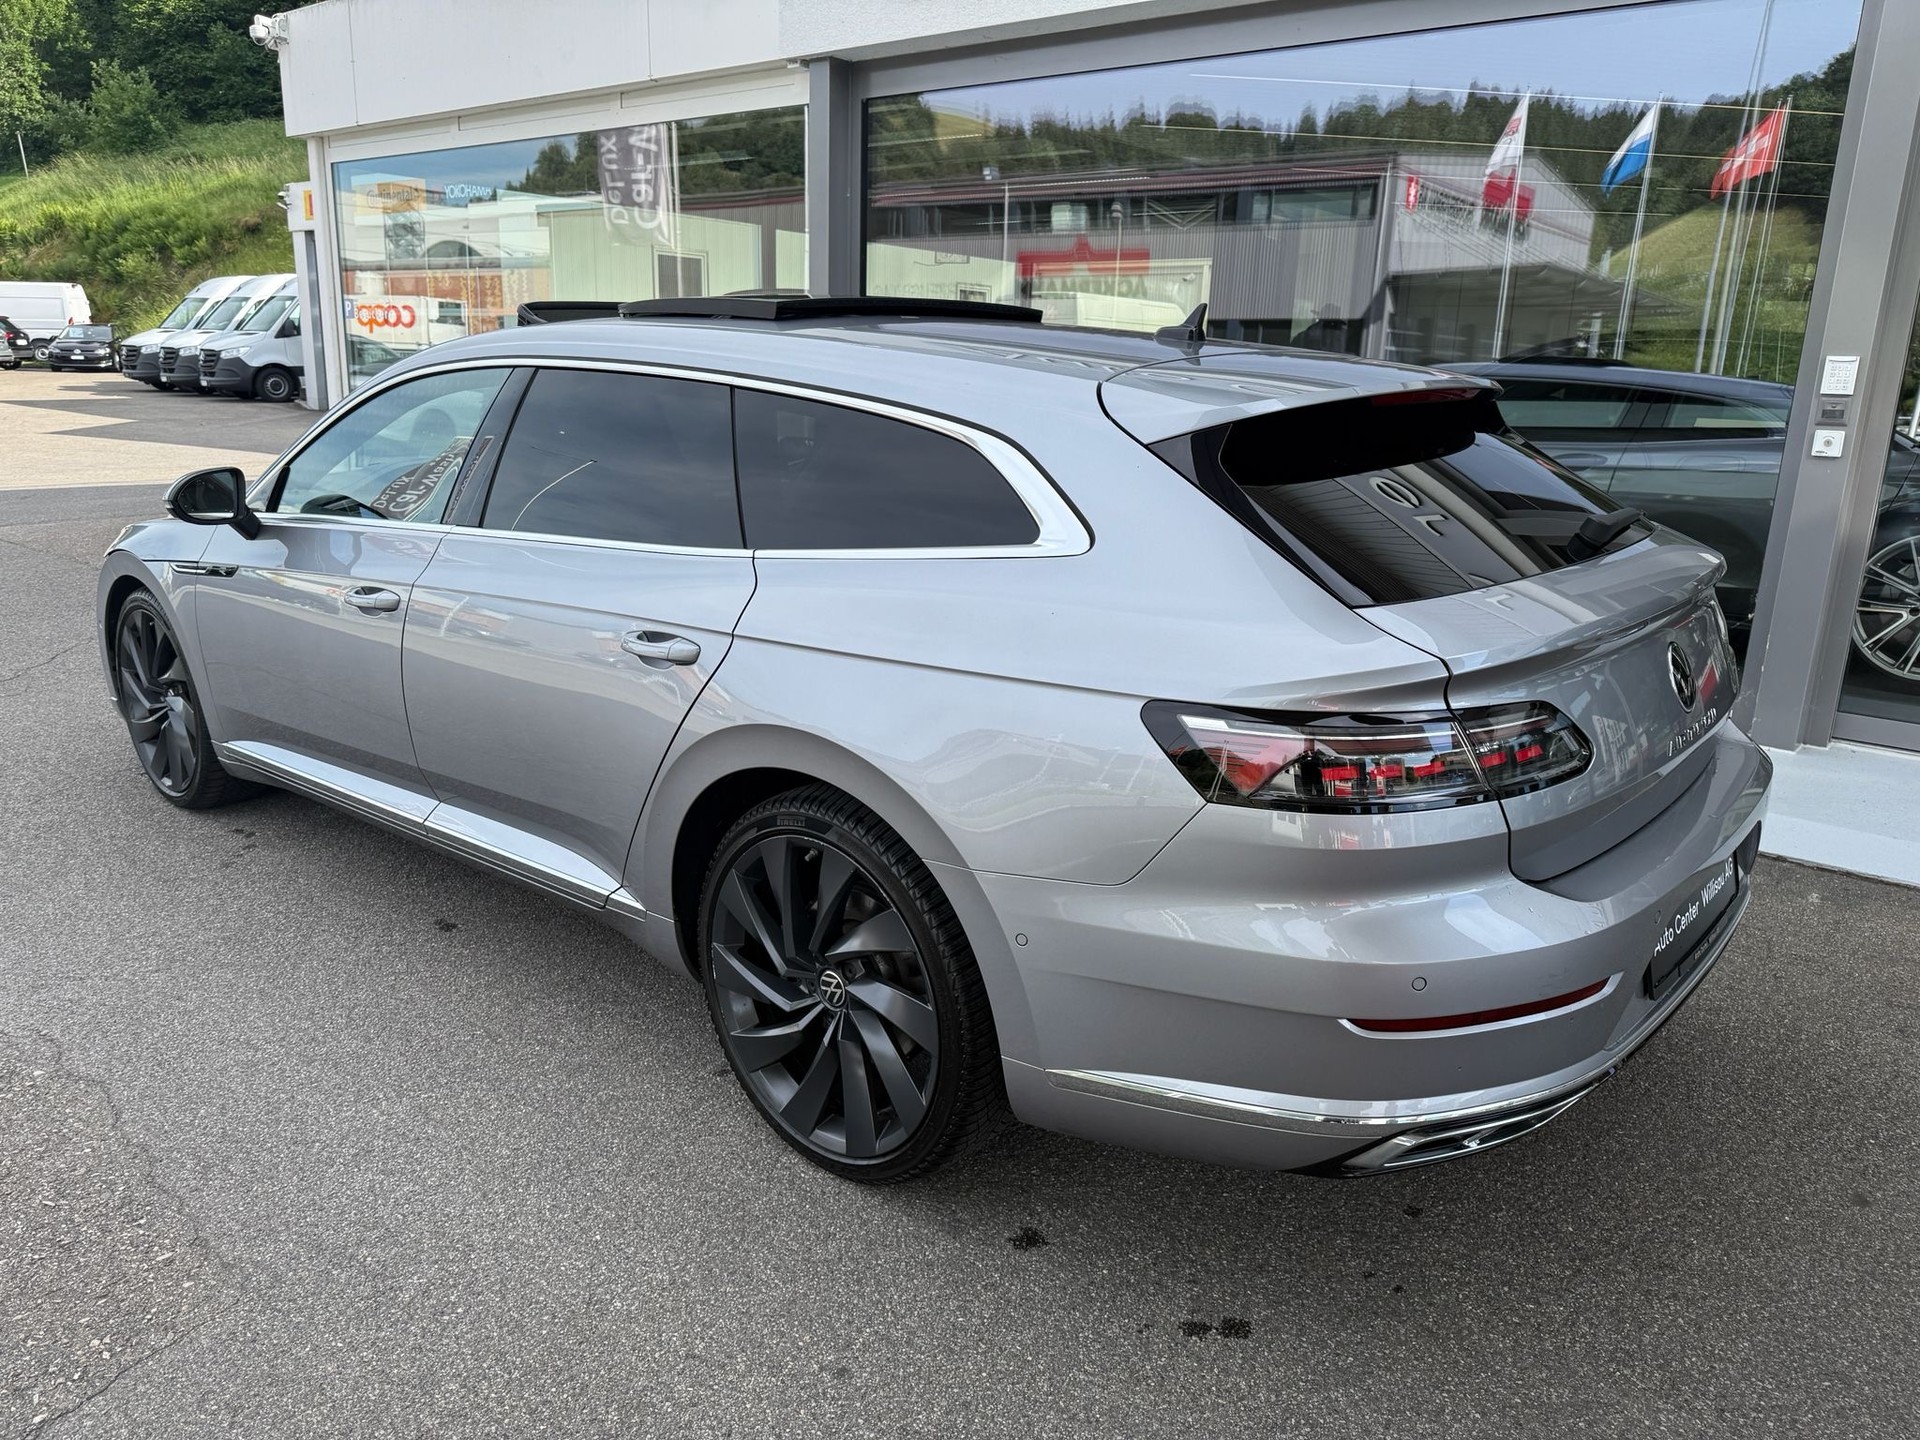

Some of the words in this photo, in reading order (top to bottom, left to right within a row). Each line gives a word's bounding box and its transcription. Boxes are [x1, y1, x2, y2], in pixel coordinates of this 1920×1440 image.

[444, 183, 492, 199] YOKOHAMA
[1654, 927, 1674, 957] Auto
[1674, 900, 1699, 934] Center
[1701, 872, 1725, 907] Willisau
[1725, 857, 1734, 881] AG
